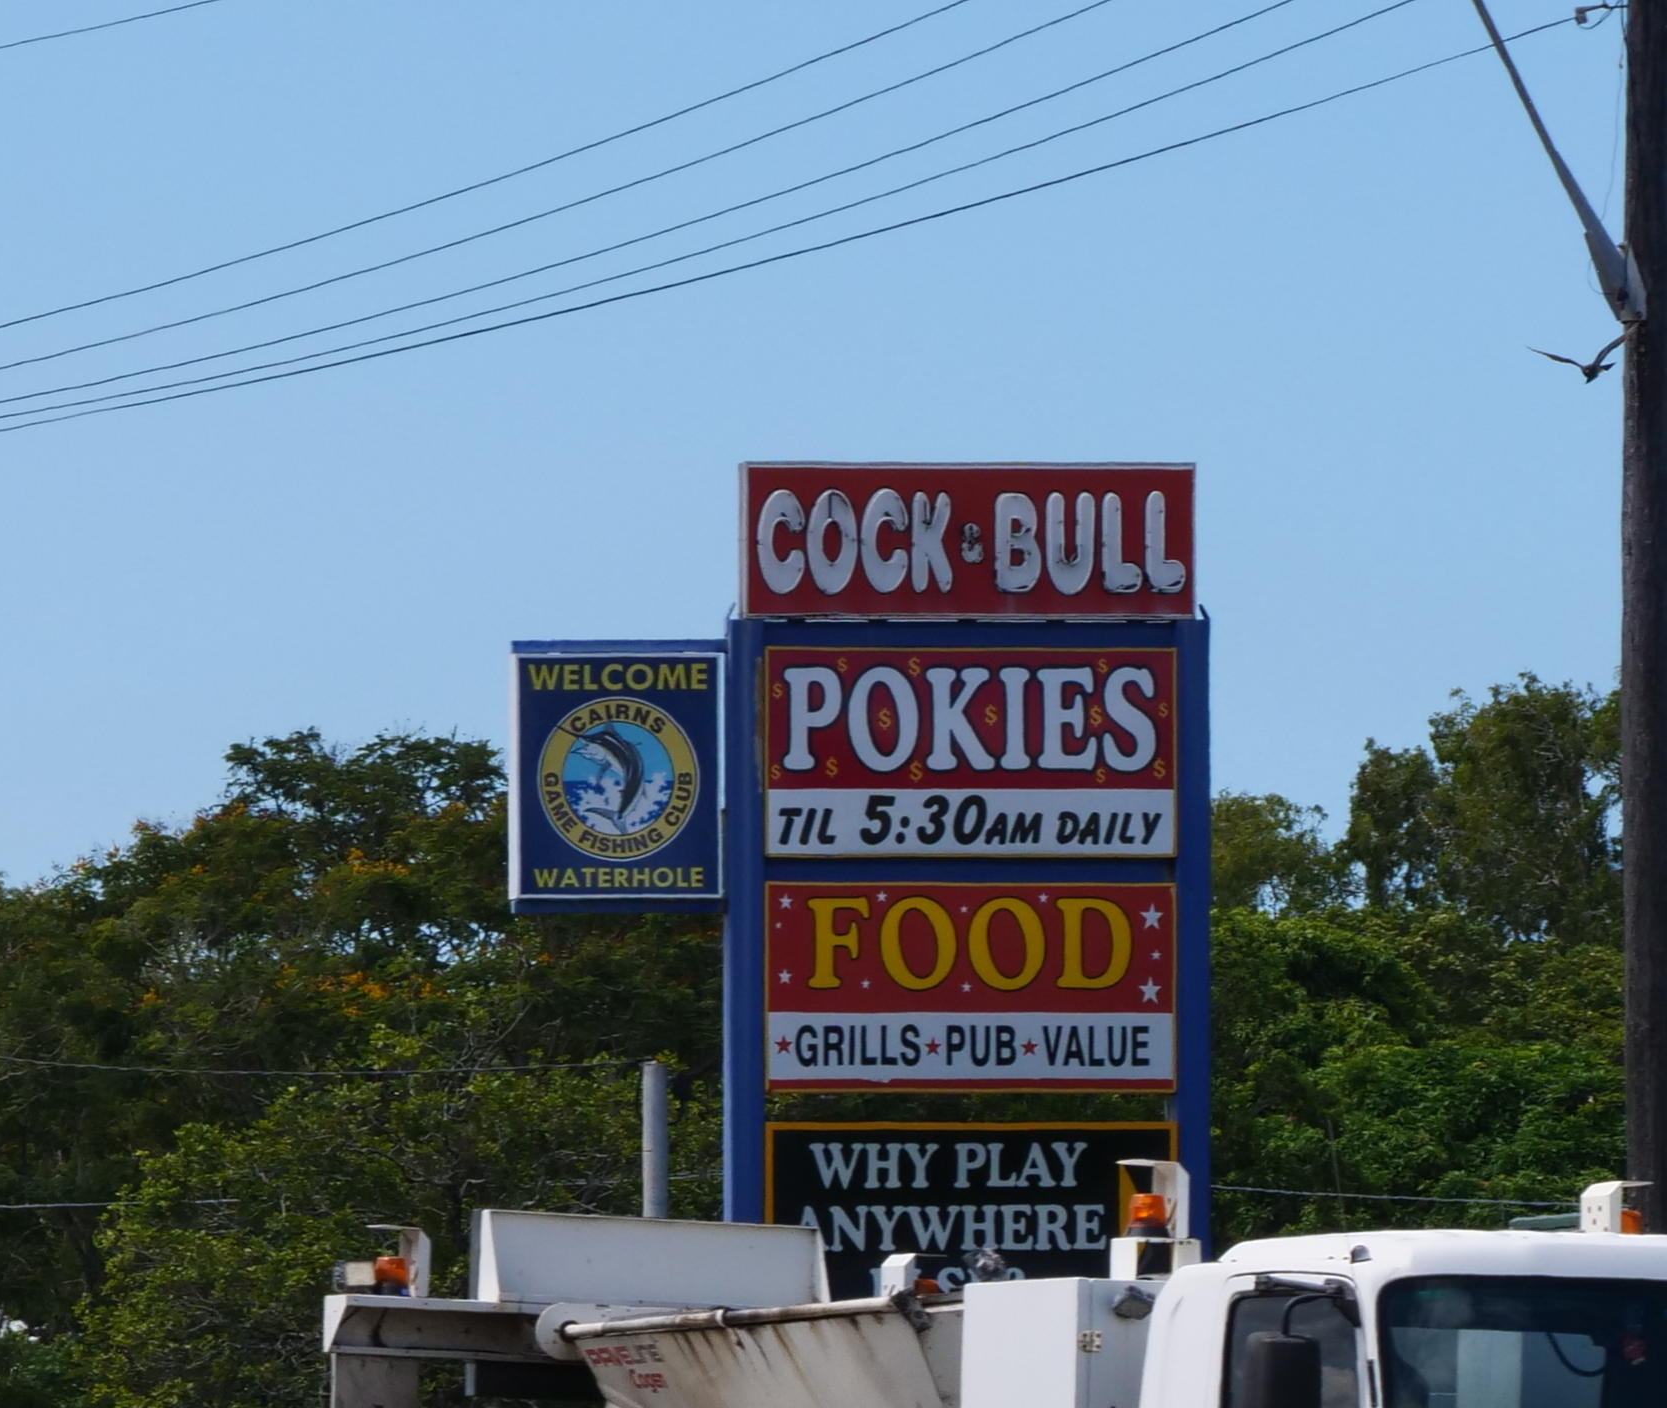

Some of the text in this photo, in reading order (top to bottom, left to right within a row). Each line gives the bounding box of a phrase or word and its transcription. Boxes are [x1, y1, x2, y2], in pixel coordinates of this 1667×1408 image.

[757, 489, 1186, 595] COCK & BULL
[528, 664, 708, 691] WELCOME
[569, 703, 666, 734] CAIRNS
[783, 665, 1158, 772] POKIES
[544, 772, 693, 854] GAME FISHING CLUB
[778, 795, 1162, 846] TIL 5:30AM DAILY
[533, 868, 704, 888] WATERHOLE
[808, 897, 1133, 991] FOOD
[795, 1025, 1150, 1067] GRILLS PUB VALUE
[808, 1142, 1087, 1191] WHY PLAY
